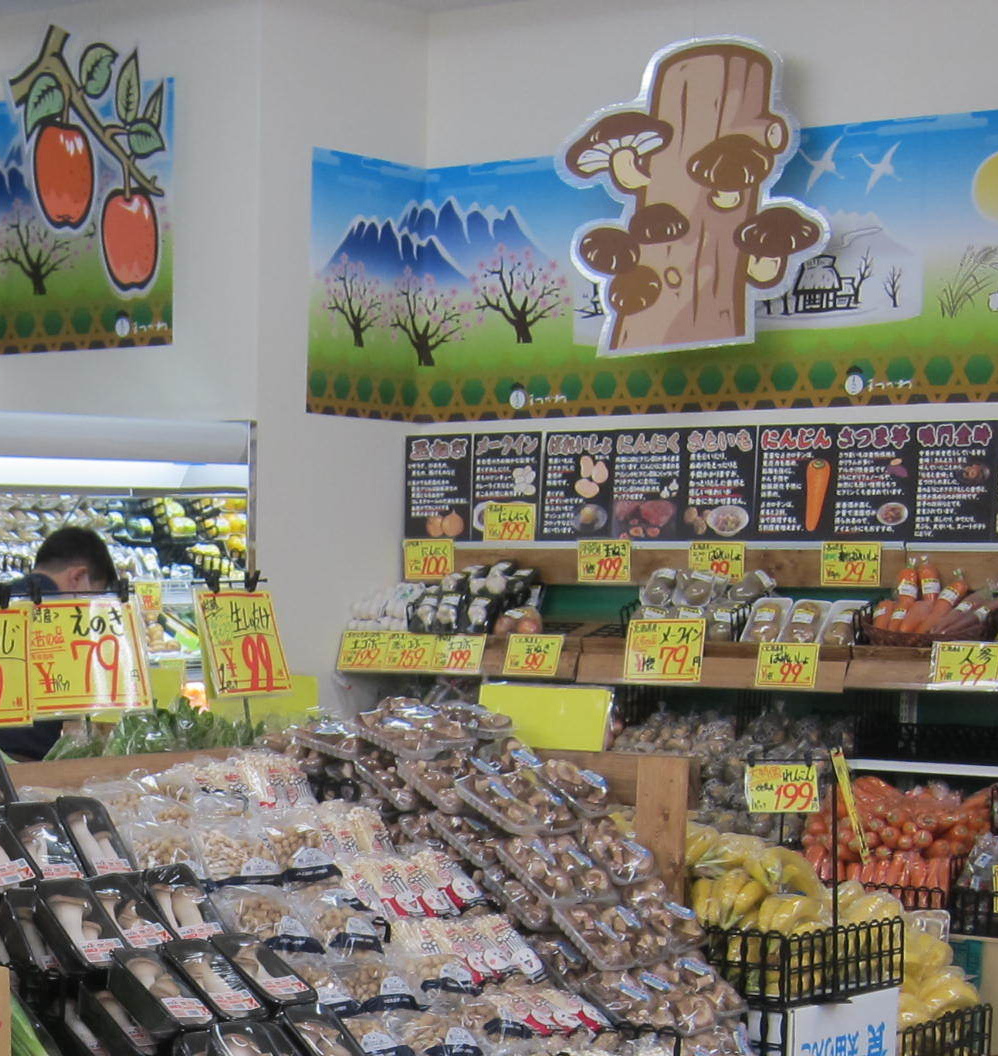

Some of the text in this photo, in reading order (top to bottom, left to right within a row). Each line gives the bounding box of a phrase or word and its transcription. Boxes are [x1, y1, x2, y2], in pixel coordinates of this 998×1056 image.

[477, 434, 538, 455] メークイン
[616, 431, 681, 454] にんにく
[687, 429, 752, 451] さといも
[761, 427, 832, 449] にんじん
[837, 423, 910, 449] さつま芋
[596, 558, 622, 580] 199
[842, 562, 866, 582] 29
[70, 606, 124, 637] えのき
[242, 634, 273, 692] 99
[659, 645, 689, 675] 79
[959, 646, 996, 664] 人参
[70, 634, 120, 702] 79
[780, 664, 802, 683] 99
[959, 664, 988, 686] 99
[775, 782, 814, 810] 199
